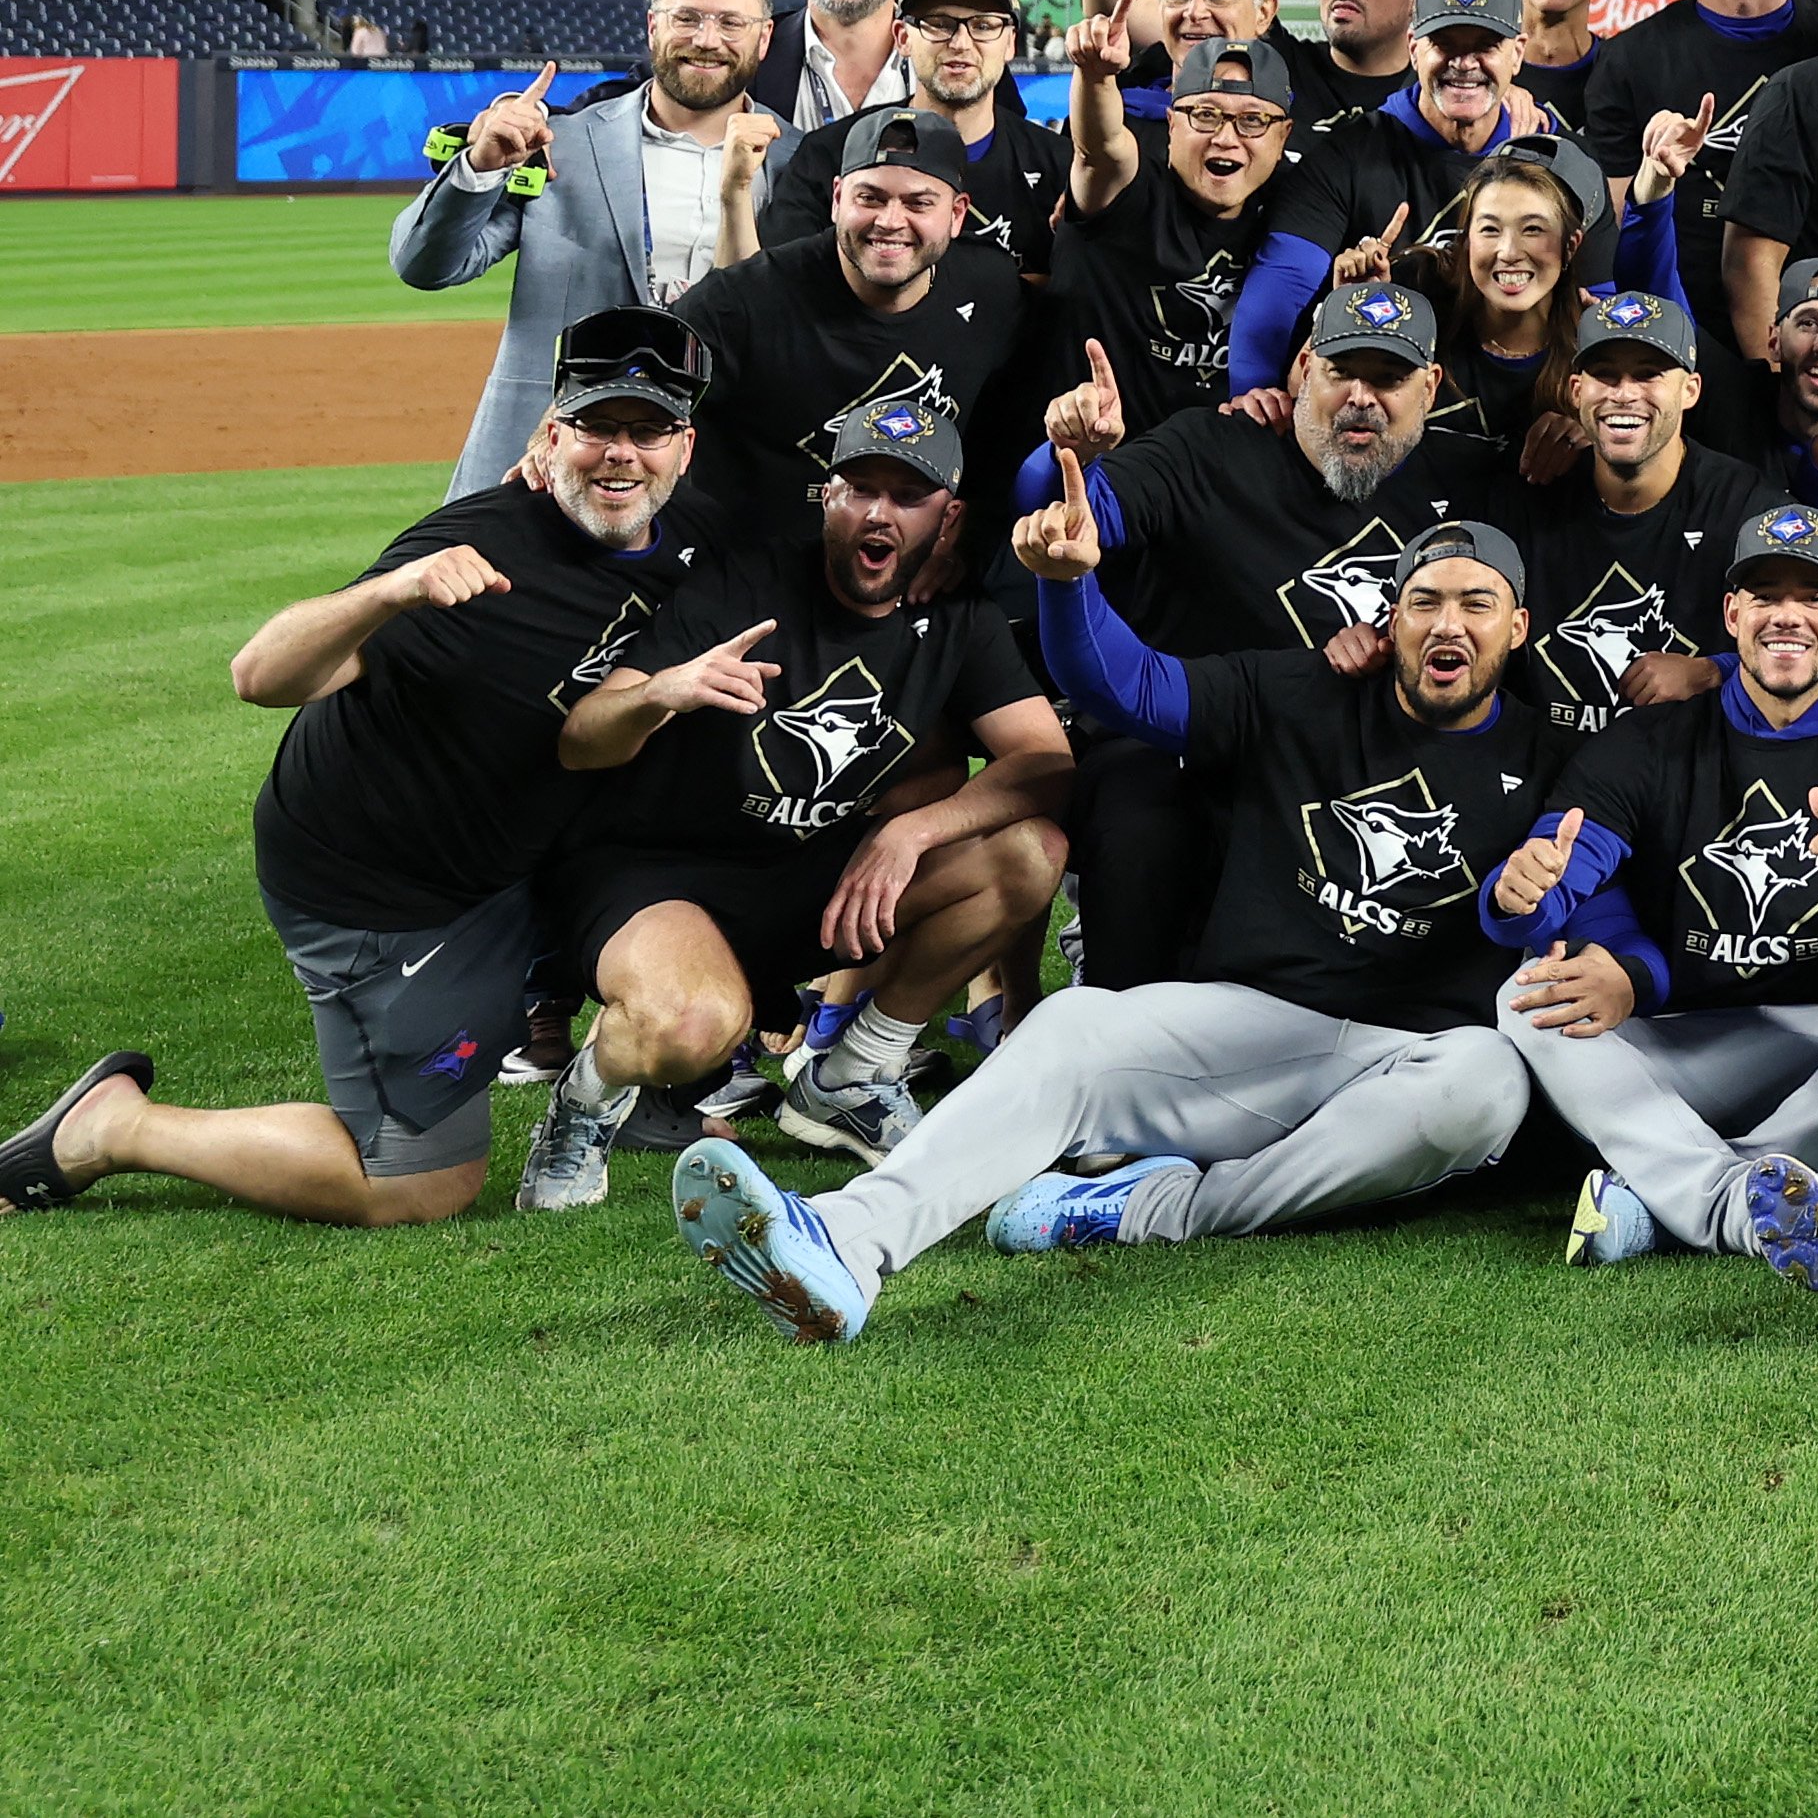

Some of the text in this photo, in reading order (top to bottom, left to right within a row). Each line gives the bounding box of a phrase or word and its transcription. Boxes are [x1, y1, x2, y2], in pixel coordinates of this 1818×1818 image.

[1174, 343, 1229, 370] ALC
[1551, 705, 1575, 725] 20
[743, 795, 771, 816] 20
[767, 796, 856, 828] ALCS
[1318, 882, 1402, 935] ALCS
[1402, 919, 1433, 938] 25
[1687, 931, 1708, 954] 20
[1709, 933, 1790, 964] ALCS
